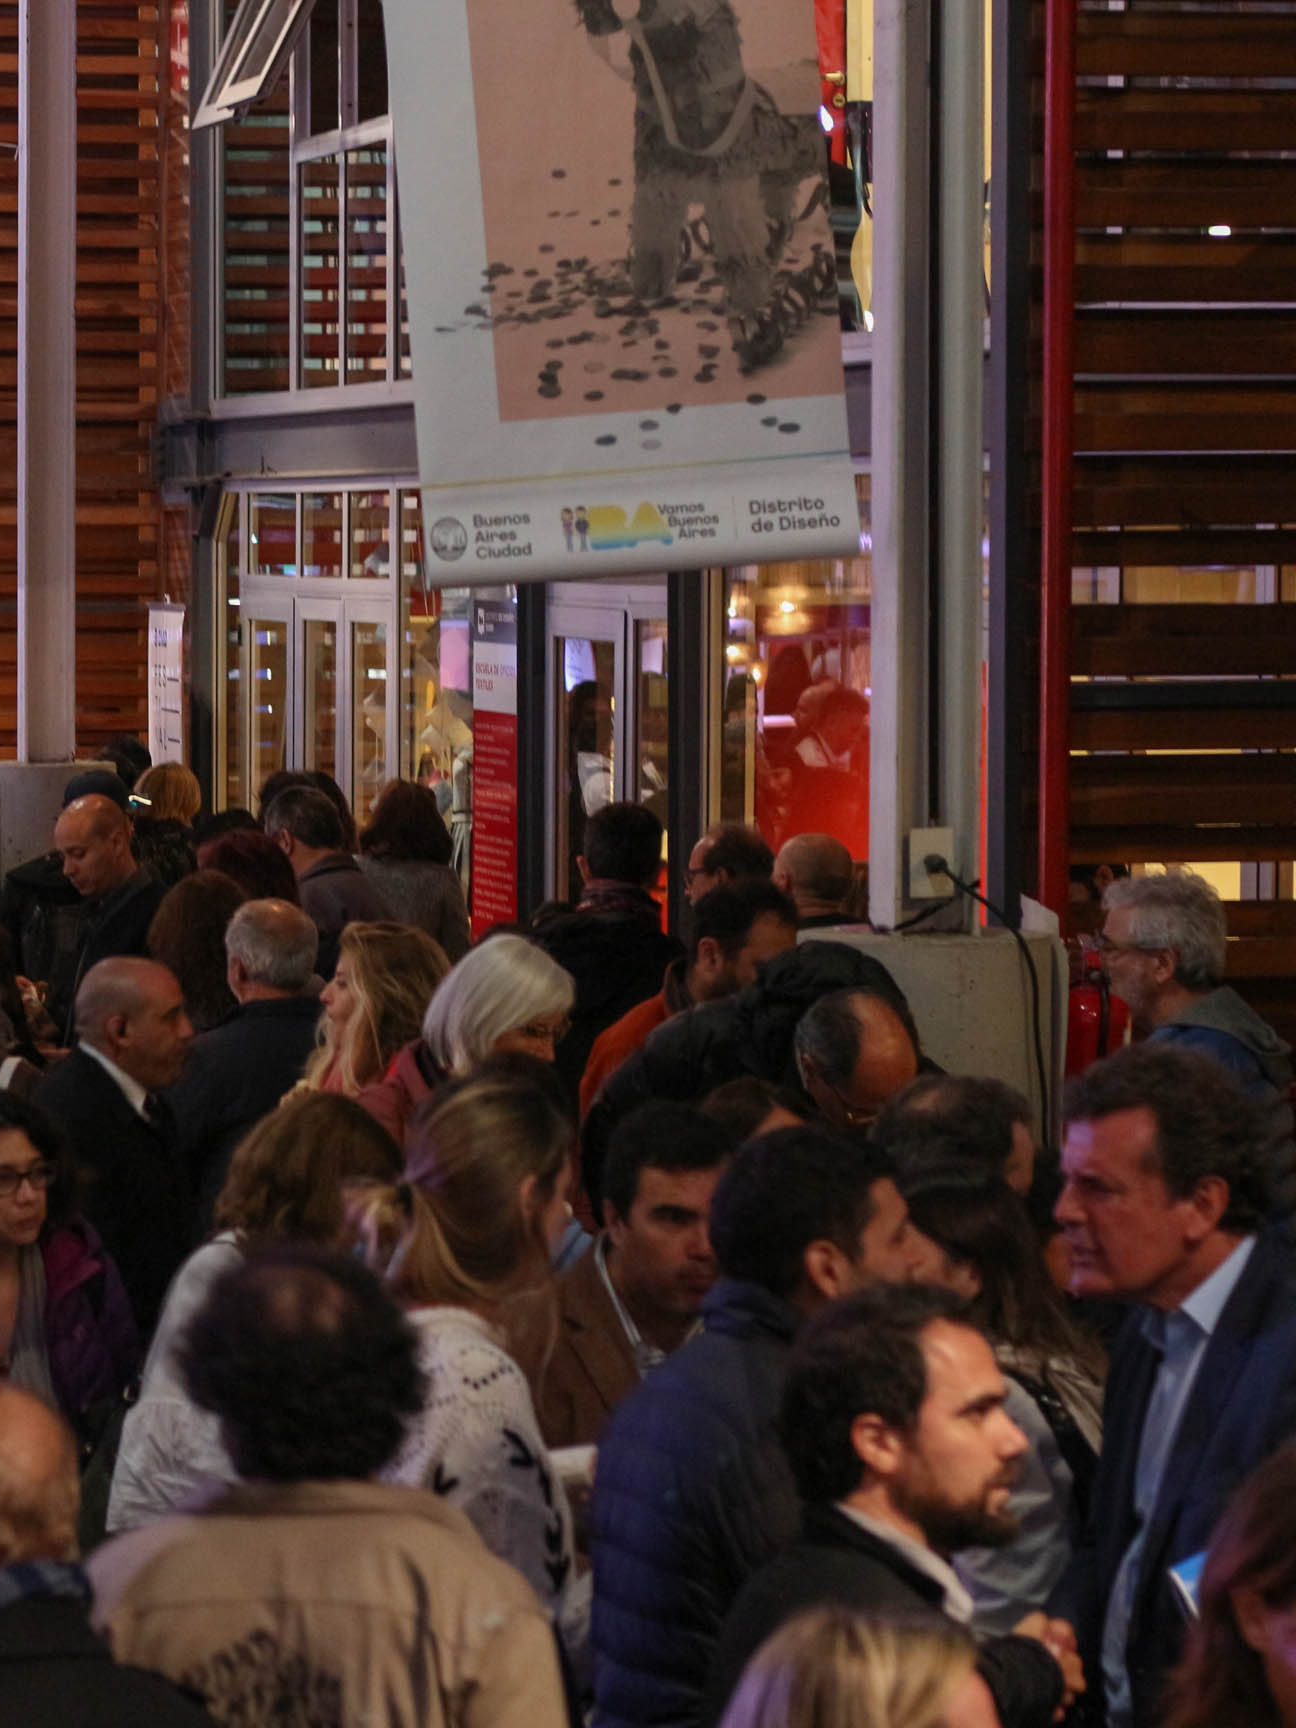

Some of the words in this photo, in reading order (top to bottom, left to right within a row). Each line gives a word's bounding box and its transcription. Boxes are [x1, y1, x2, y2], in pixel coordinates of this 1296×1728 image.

[657, 502, 705, 515] Vamos
[749, 496, 825, 515] Distrito
[473, 513, 531, 528] Buenos
[668, 514, 720, 528] Buenos
[751, 517, 774, 533] de
[779, 511, 841, 531] Diseño
[475, 530, 518, 543] Aires
[679, 527, 717, 540] Aires
[476, 542, 533, 560] Ciudad
